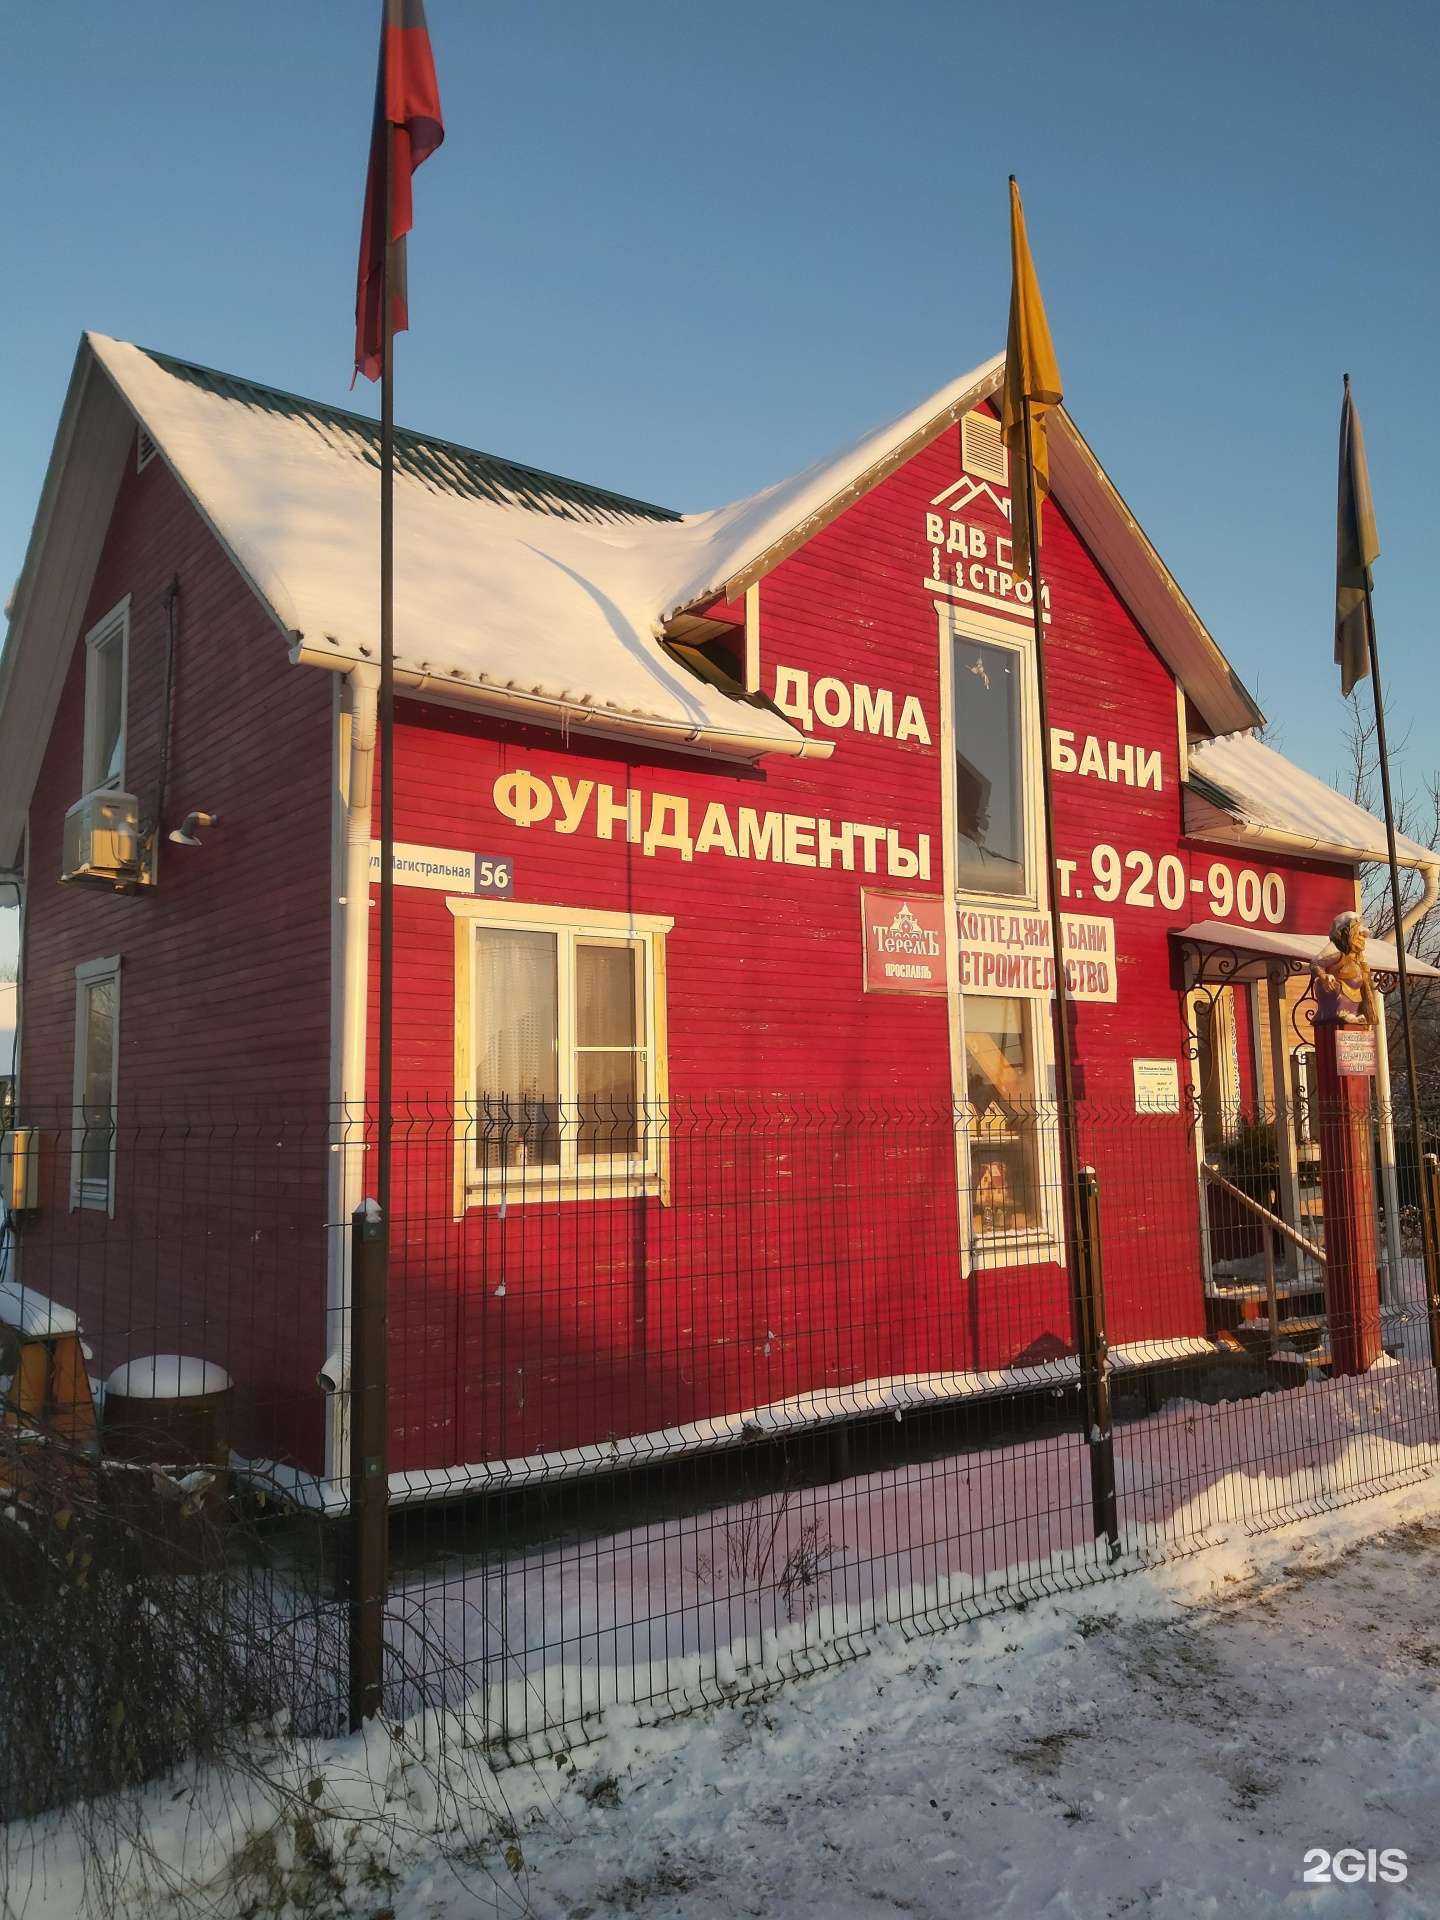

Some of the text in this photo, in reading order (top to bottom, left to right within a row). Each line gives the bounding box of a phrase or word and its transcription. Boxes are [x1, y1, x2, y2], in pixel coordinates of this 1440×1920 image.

[926, 512, 987, 559] ВДВ
[774, 665, 932, 745] ДОМА
[1050, 728, 1163, 791] БАНИ
[492, 769, 931, 881] ФУНДАМЕНТЫ
[480, 861, 508, 888] 56
[1091, 844, 1286, 925] 920-900
[956, 911, 1050, 950] КОТТЕДЖИ
[1067, 922, 1107, 952] БАНИ
[959, 950, 1109, 993] СТРОИТЕЛСТВО
